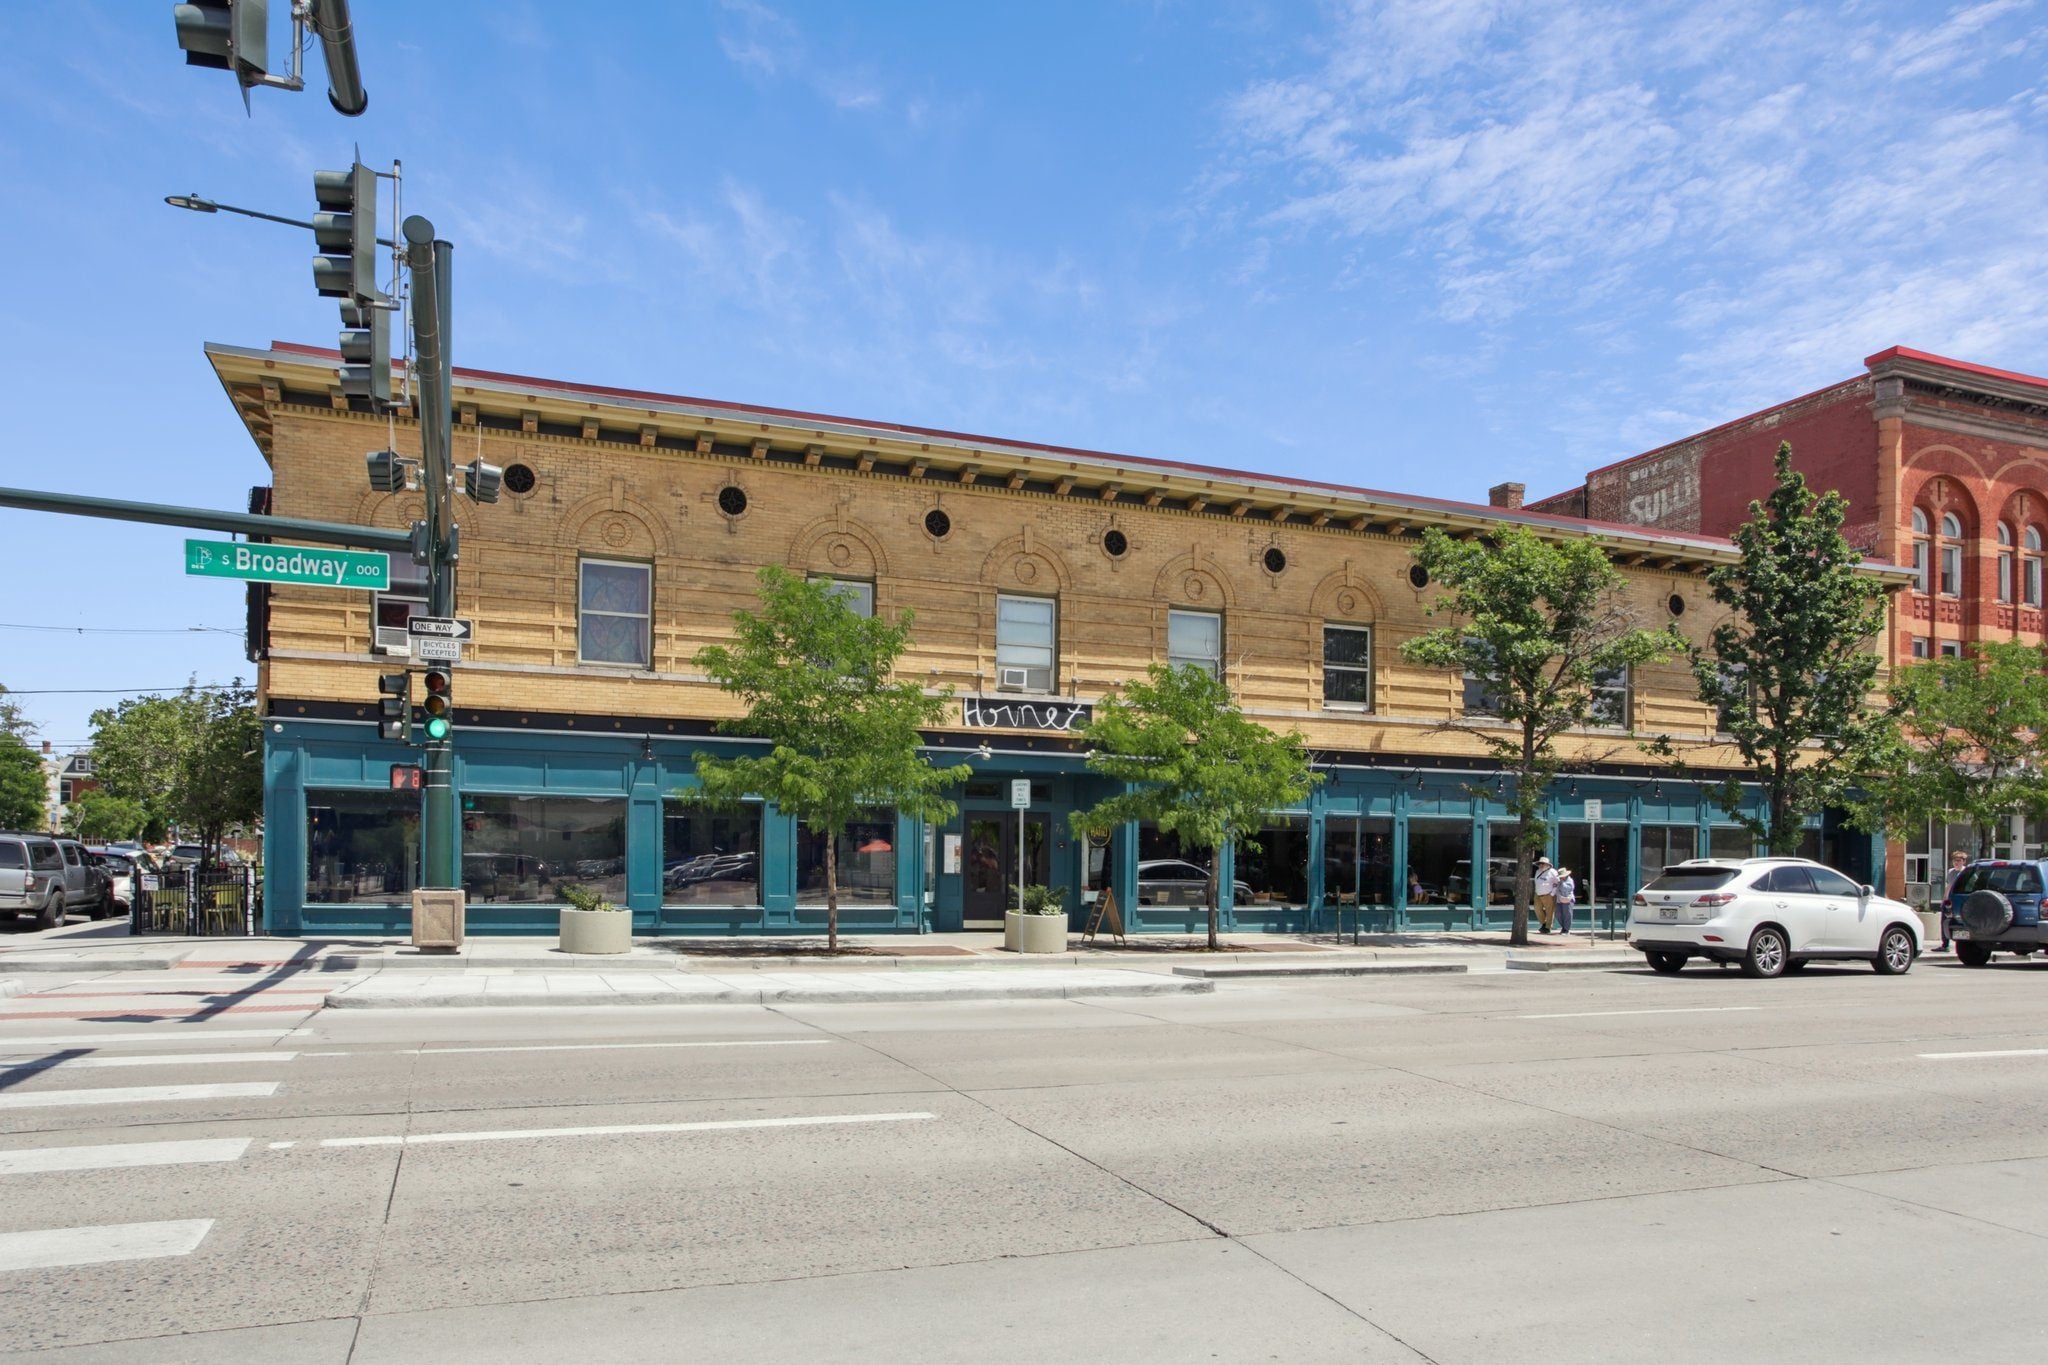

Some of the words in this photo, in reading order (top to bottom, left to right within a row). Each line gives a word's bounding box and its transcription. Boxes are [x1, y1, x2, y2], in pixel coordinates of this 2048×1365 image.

[222, 554, 230, 565] S
[235, 547, 349, 585] Broadway
[356, 564, 381, 577] 000
[414, 622, 432, 631] ONE
[435, 624, 453, 632] WAY
[423, 640, 456, 649] BICYCLES
[422, 649, 457, 657] EXCEPTED
